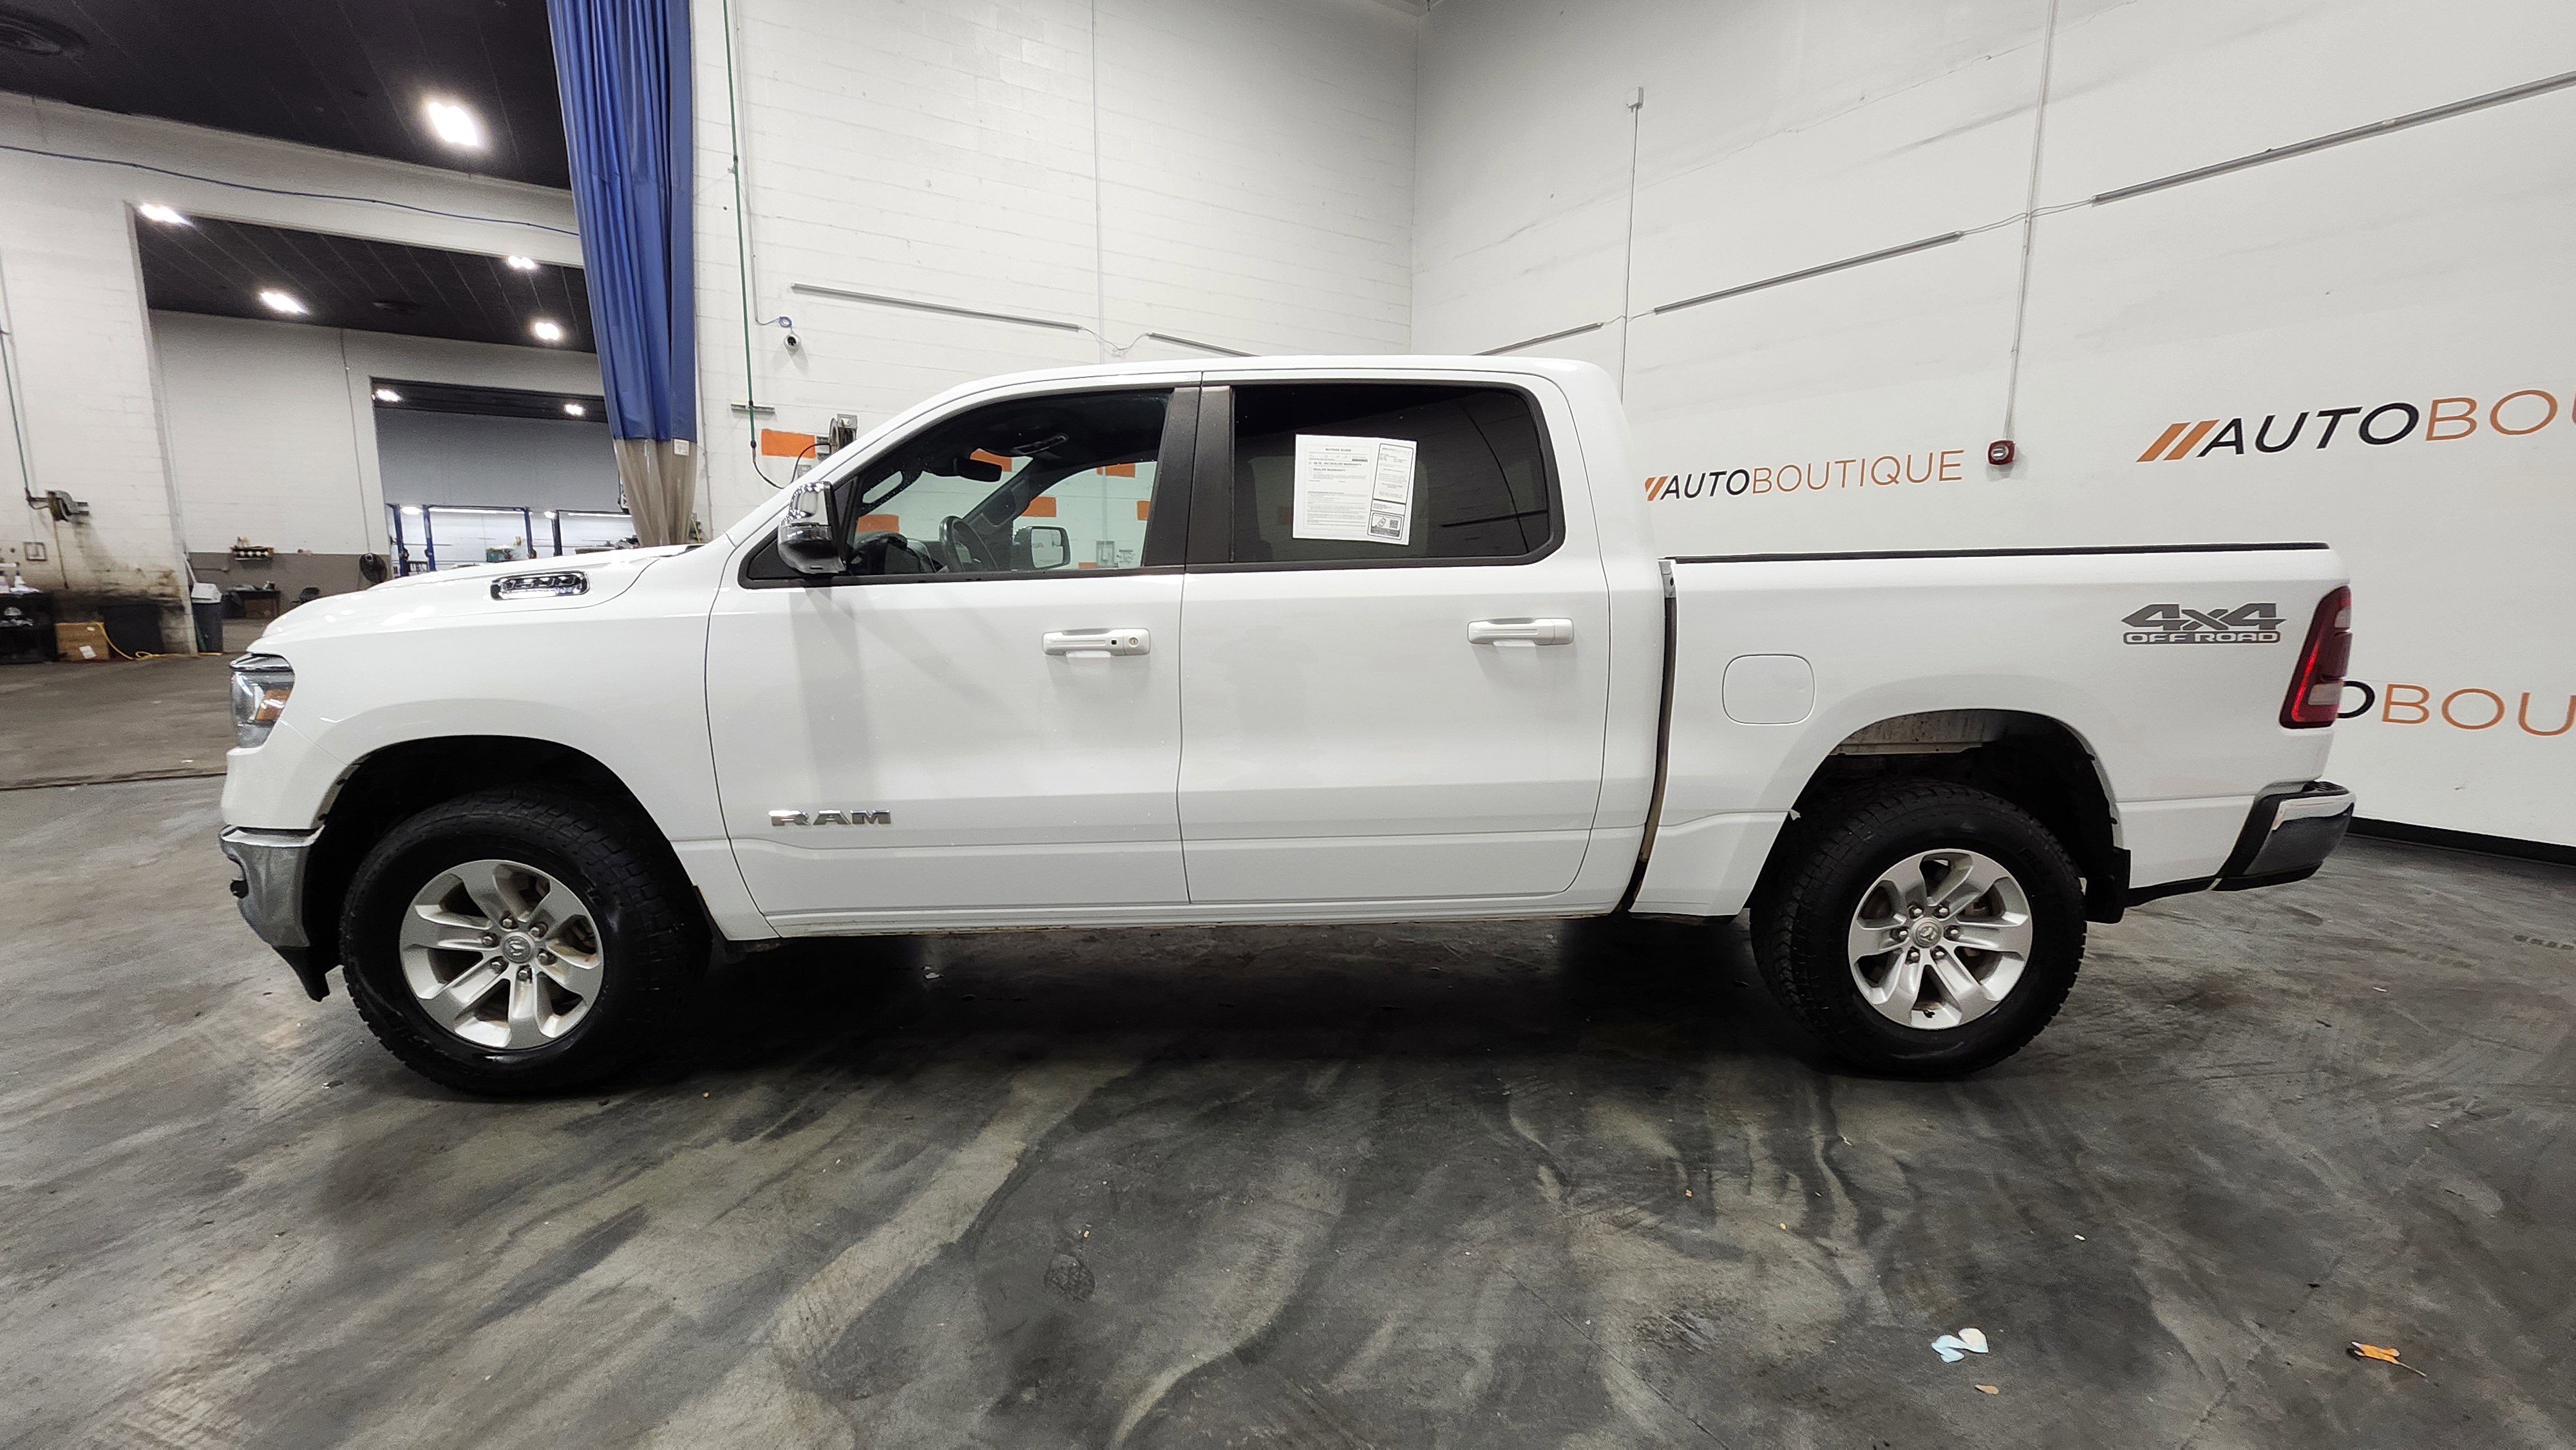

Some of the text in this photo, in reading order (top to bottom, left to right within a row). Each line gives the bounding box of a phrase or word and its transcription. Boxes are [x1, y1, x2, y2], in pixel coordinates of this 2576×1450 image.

[2196, 389, 2576, 458] AUTOBO
[1660, 449, 1965, 500] AUTOBOUTIQUE
[2126, 632, 2278, 643] OFF ROAD
[768, 809, 892, 827] RAM
